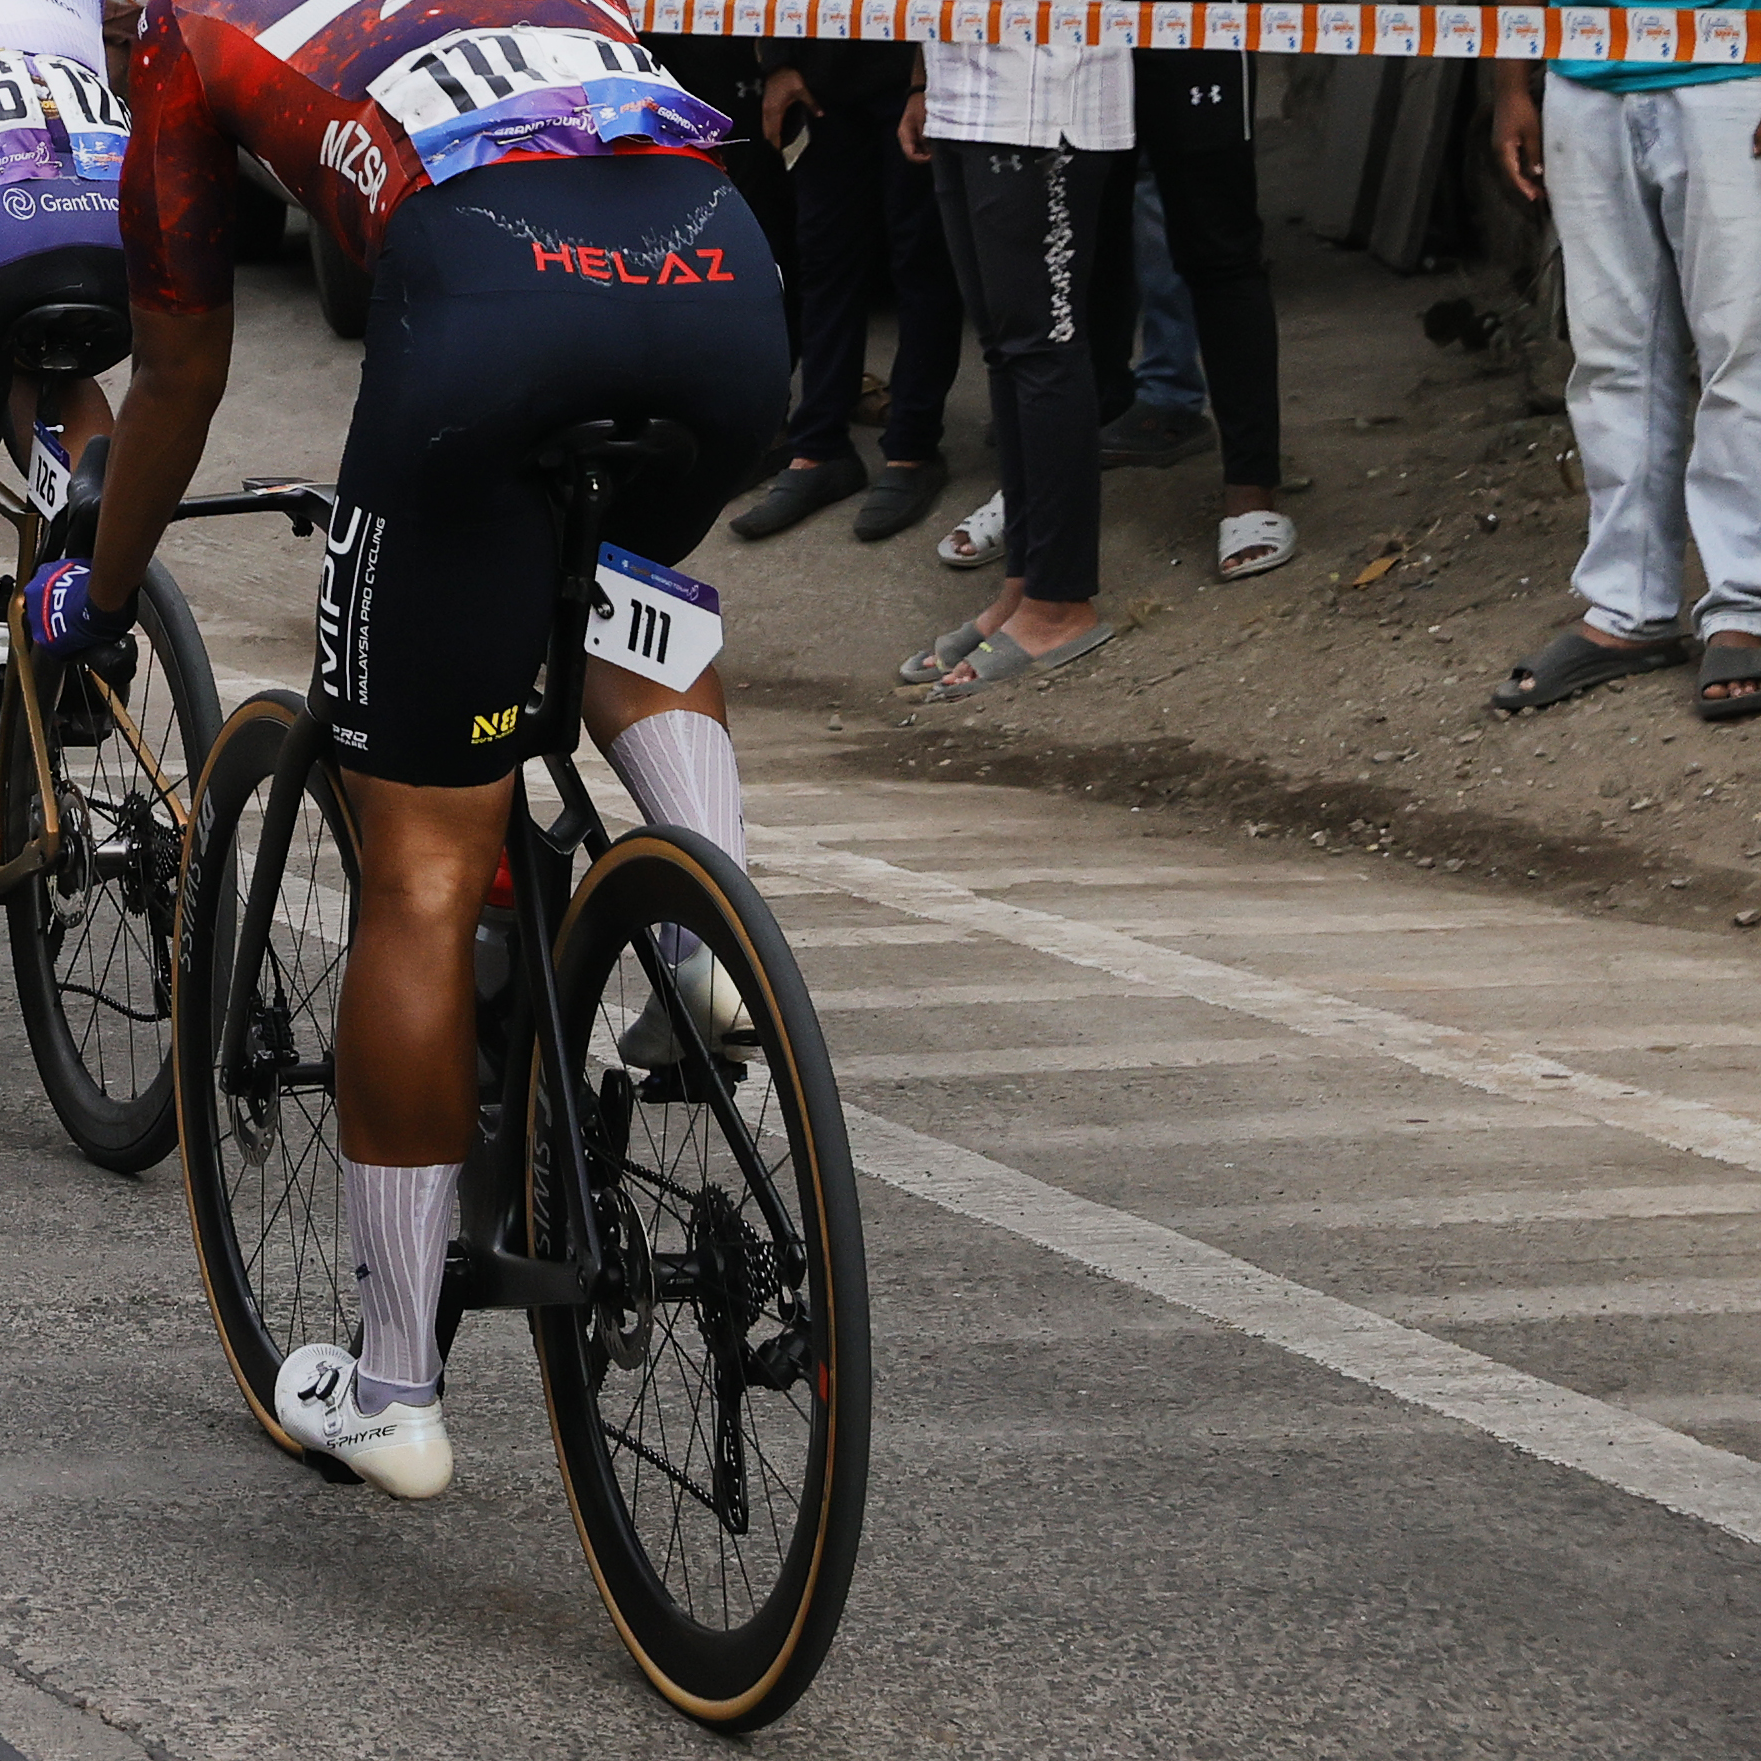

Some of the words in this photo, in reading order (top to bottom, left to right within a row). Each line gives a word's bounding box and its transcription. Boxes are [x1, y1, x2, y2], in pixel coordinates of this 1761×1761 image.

[40, 194, 92, 212] Grant
[531, 242, 735, 285] HELAZ
[35, 454, 58, 508] 126
[365, 516, 386, 586] CYCLING
[50, 564, 91, 638] MPC
[320, 495, 362, 698] MPC
[360, 587, 373, 622] PRO
[627, 598, 672, 665] 111
[359, 626, 370, 706] MALAYSIA
[332, 724, 368, 743] PRO
